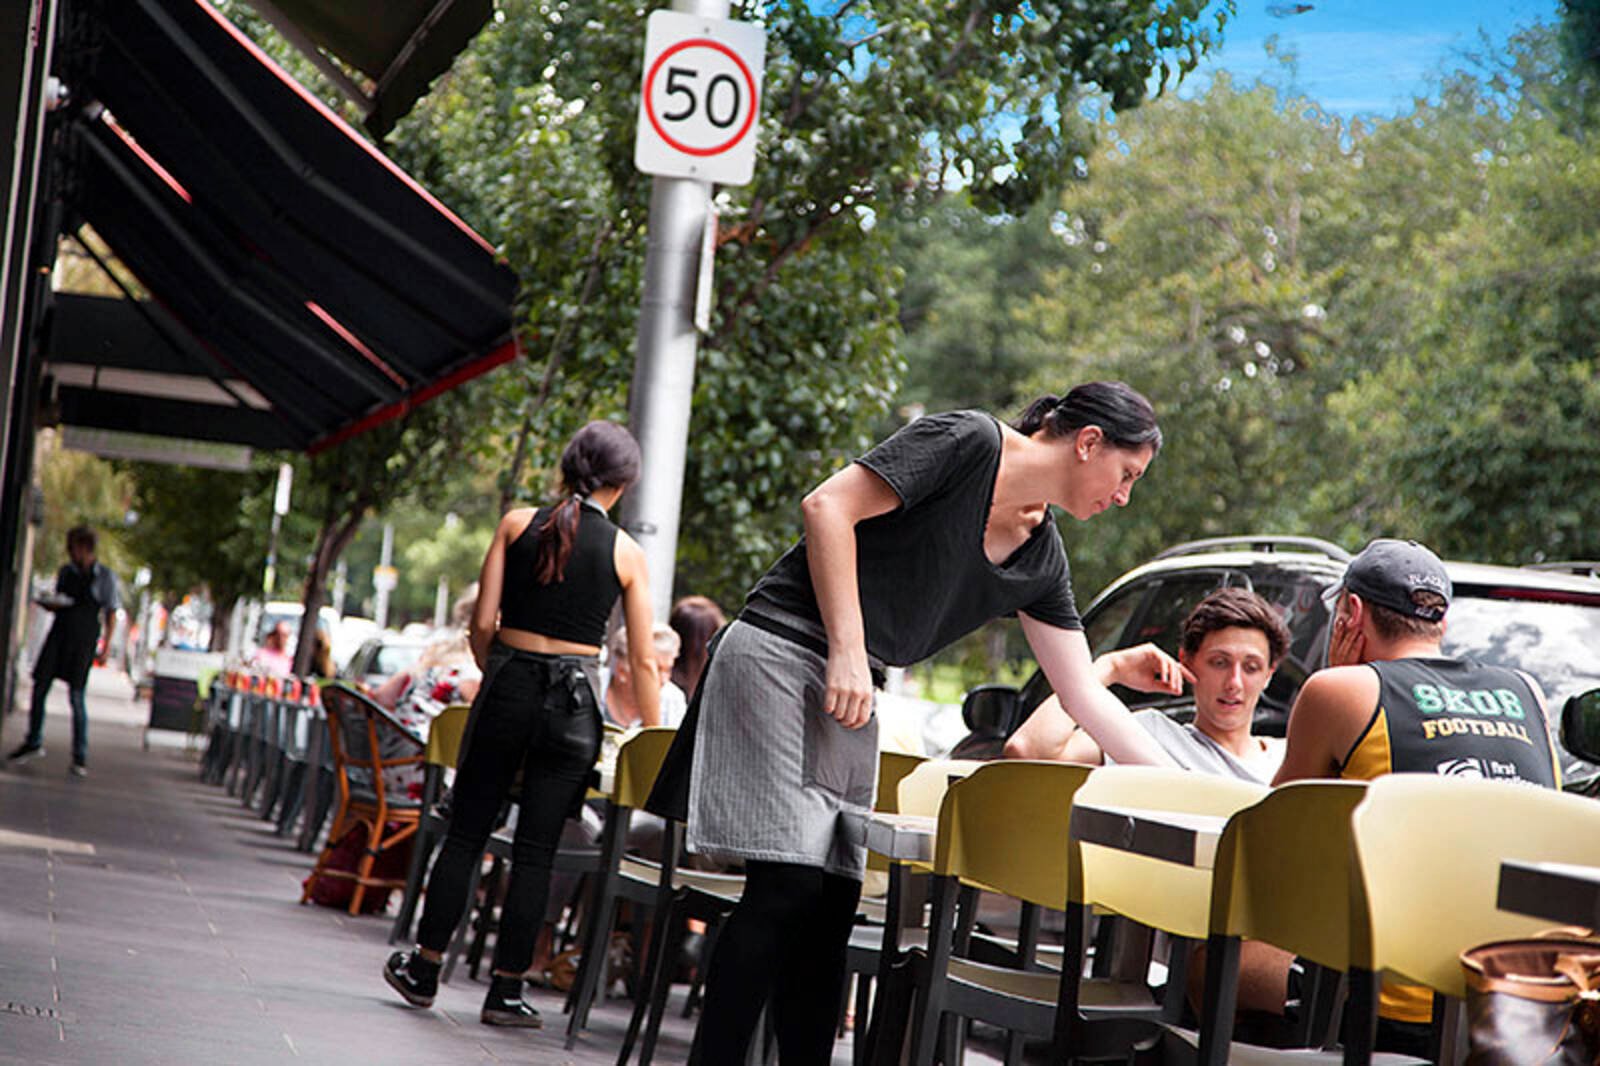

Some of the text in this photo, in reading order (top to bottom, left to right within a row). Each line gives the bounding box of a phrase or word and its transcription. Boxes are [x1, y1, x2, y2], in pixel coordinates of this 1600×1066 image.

[662, 66, 741, 129] 50
[1412, 683, 1526, 720] SKOB
[1421, 717, 1534, 746] FOOTBALL
